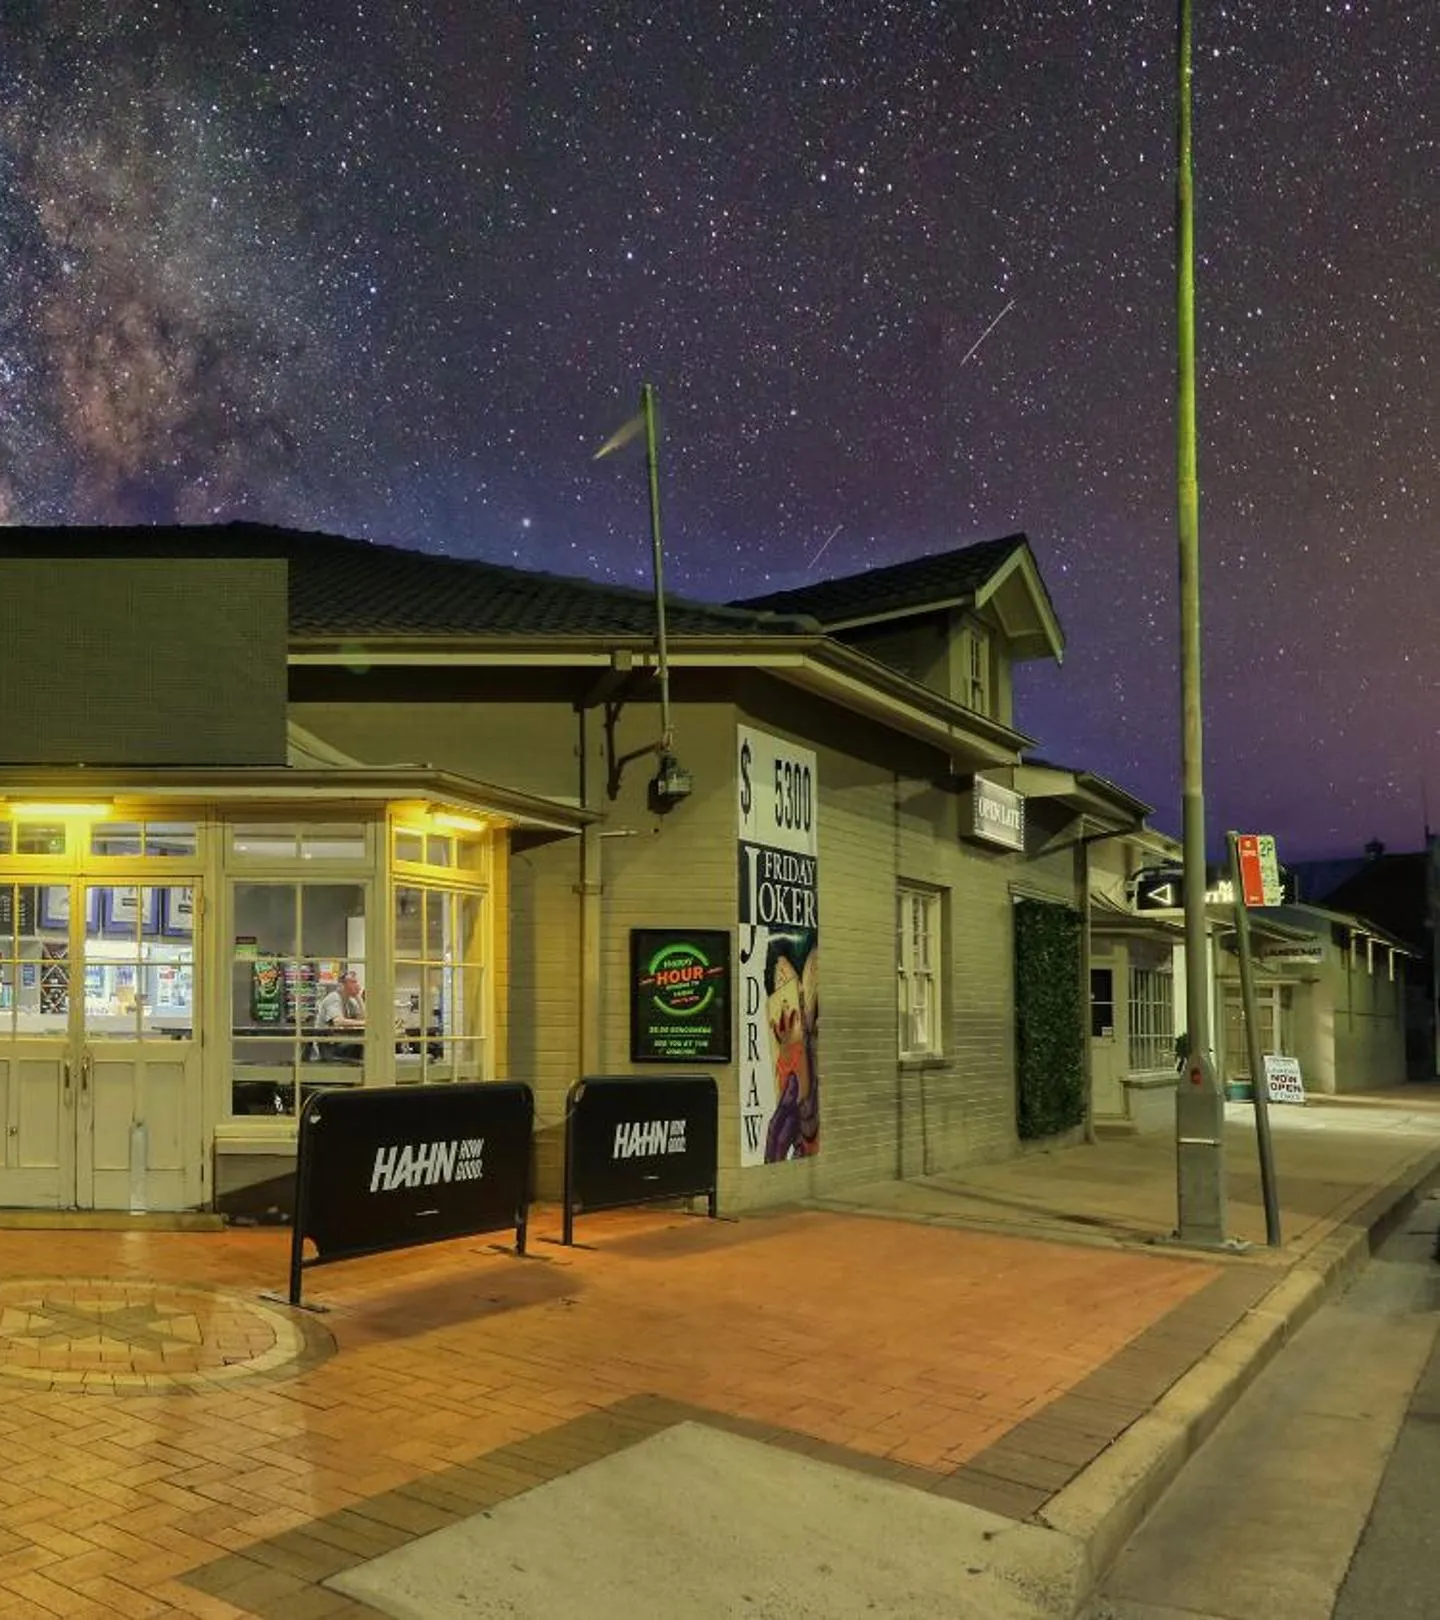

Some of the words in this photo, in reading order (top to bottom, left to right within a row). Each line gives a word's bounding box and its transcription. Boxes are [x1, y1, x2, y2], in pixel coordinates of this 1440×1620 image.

[740, 738, 752, 825] $
[774, 759, 812, 833] 5300
[978, 796, 1000, 822] OPEN
[764, 851, 815, 885] FRIDAY
[741, 846, 818, 963] JOKER
[656, 966, 704, 985] HOUR
[744, 976, 763, 1151] DRAW
[1270, 1082, 1303, 1093] OPEN
[459, 1138, 485, 1160] HOW
[613, 1120, 669, 1159] HAHN
[369, 1140, 458, 1193] HAHN
